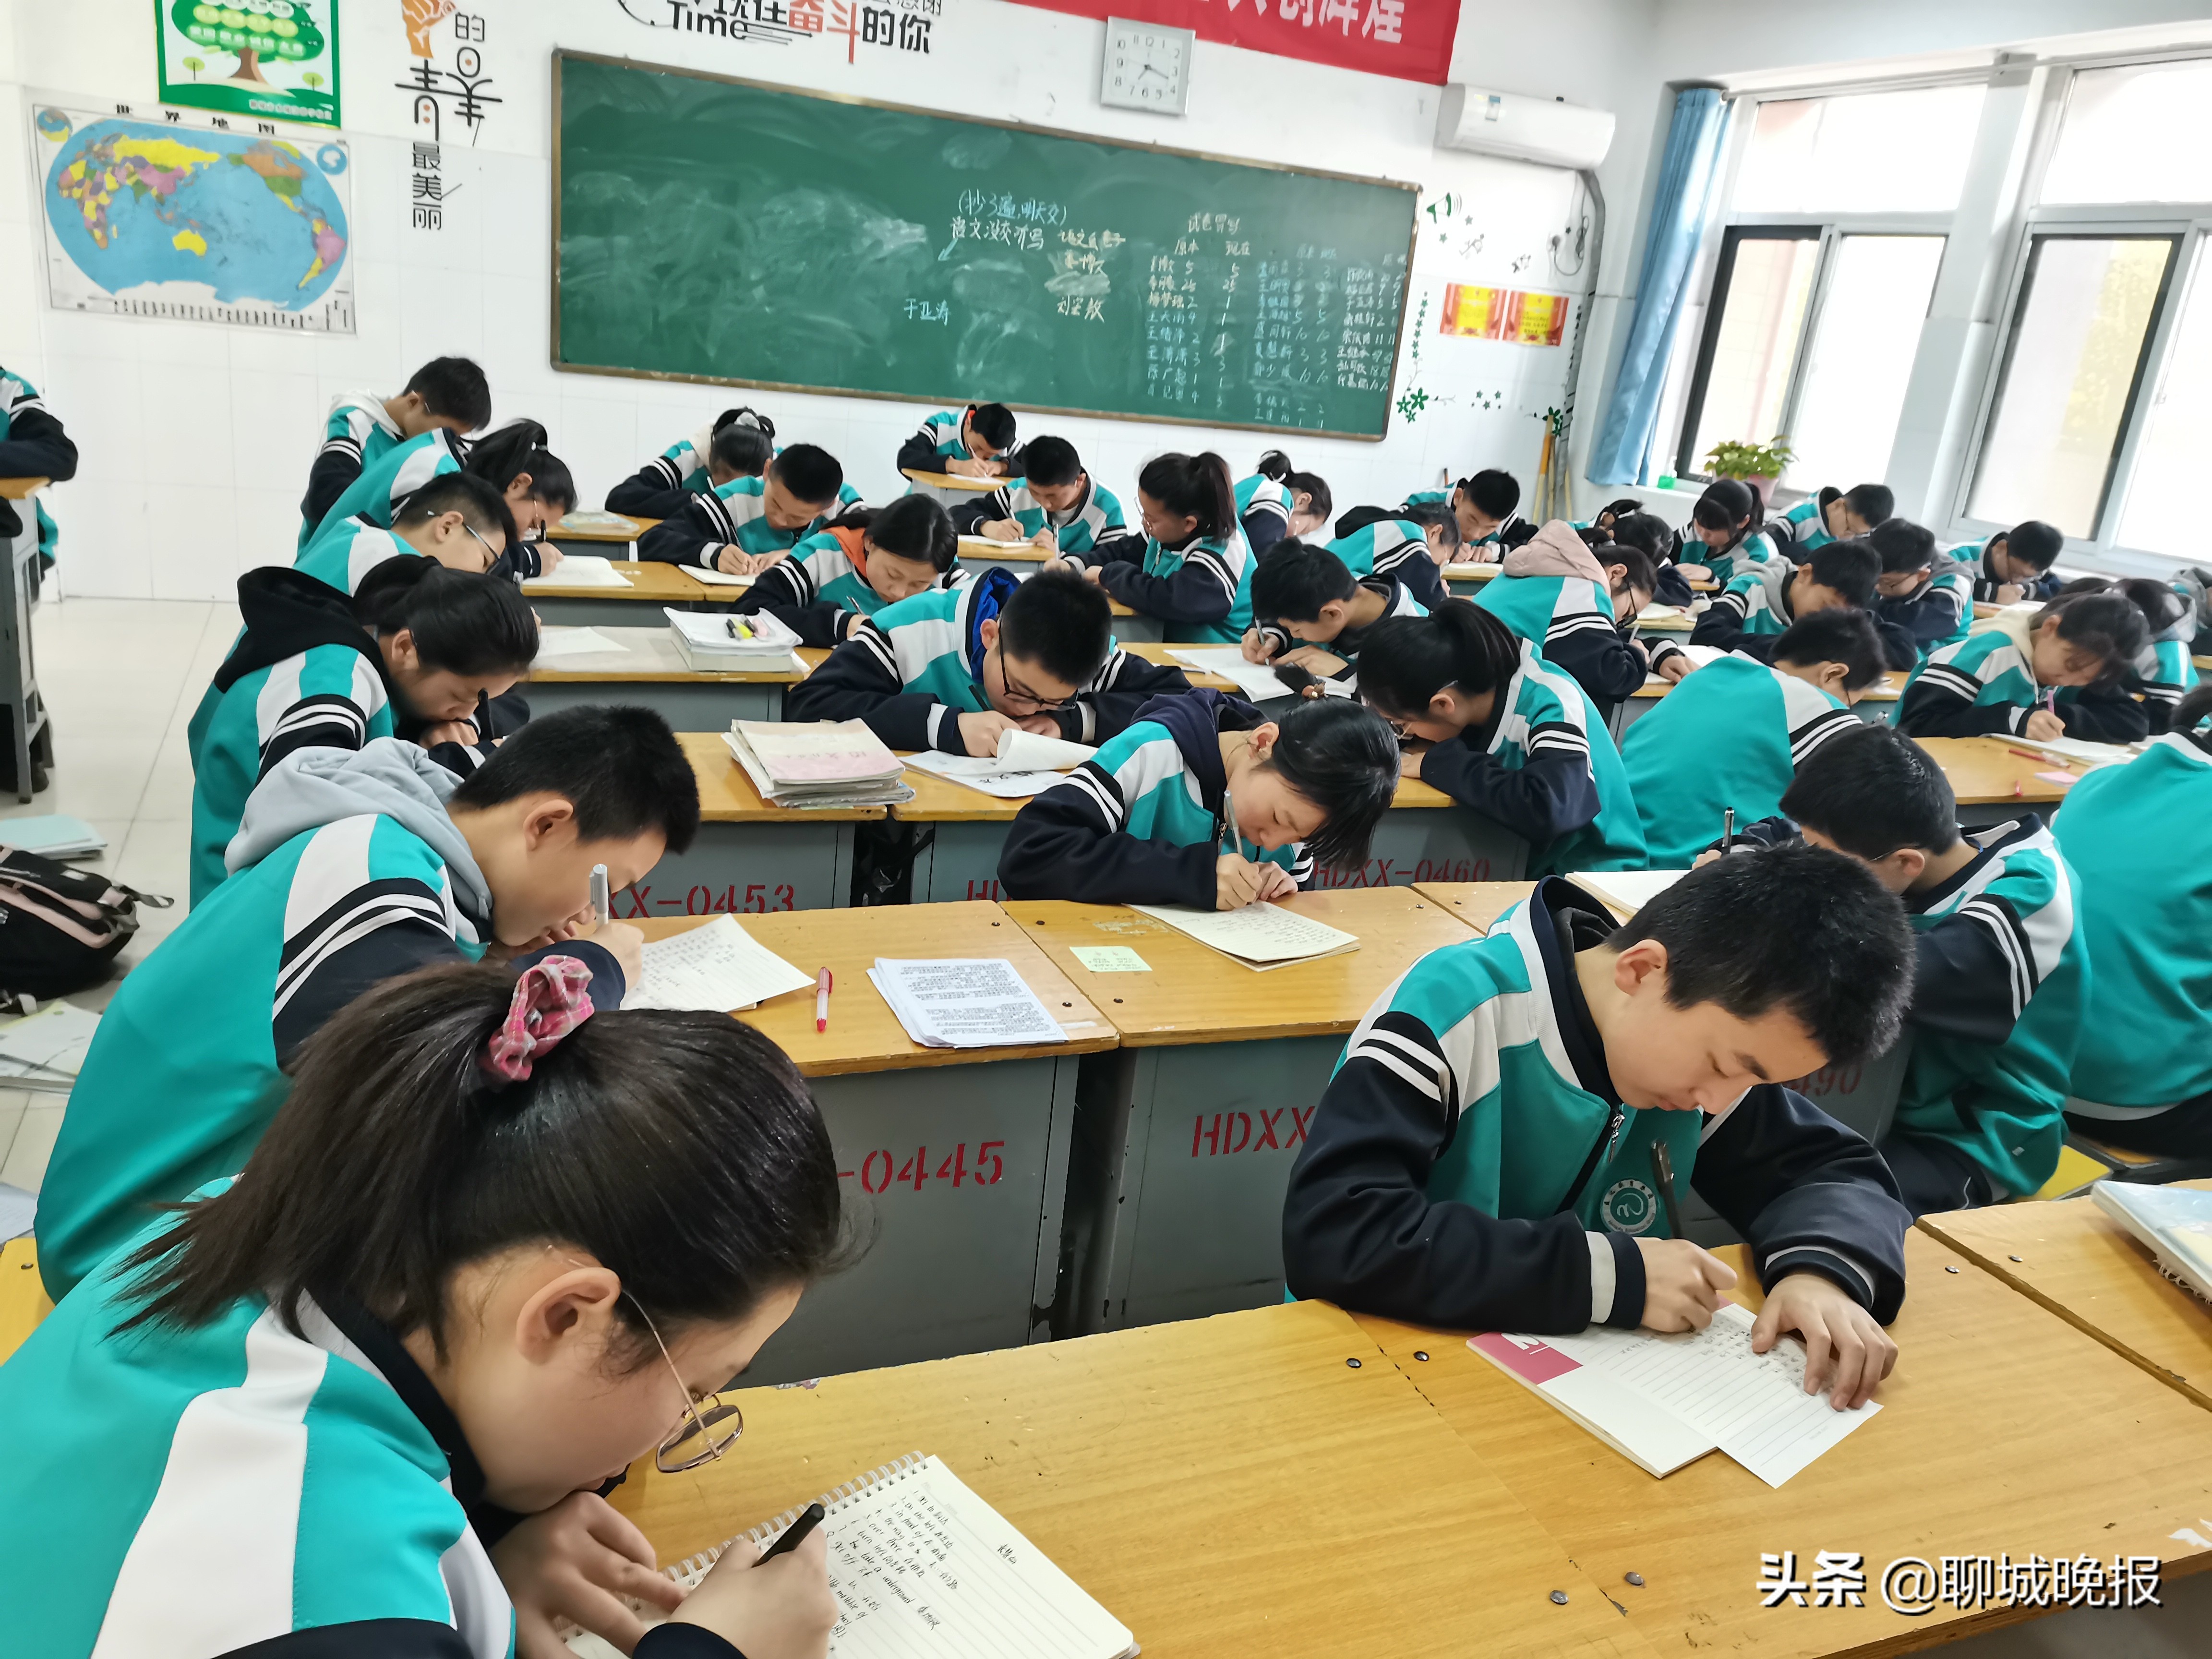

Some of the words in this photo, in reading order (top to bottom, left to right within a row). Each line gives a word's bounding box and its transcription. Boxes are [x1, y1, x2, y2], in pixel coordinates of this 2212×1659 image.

[455, 12, 485, 42] 的
[667, 0, 747, 40] Time
[1227, 0, 1405, 43] 创辉煌
[412, 142, 442, 230] 最美丽
